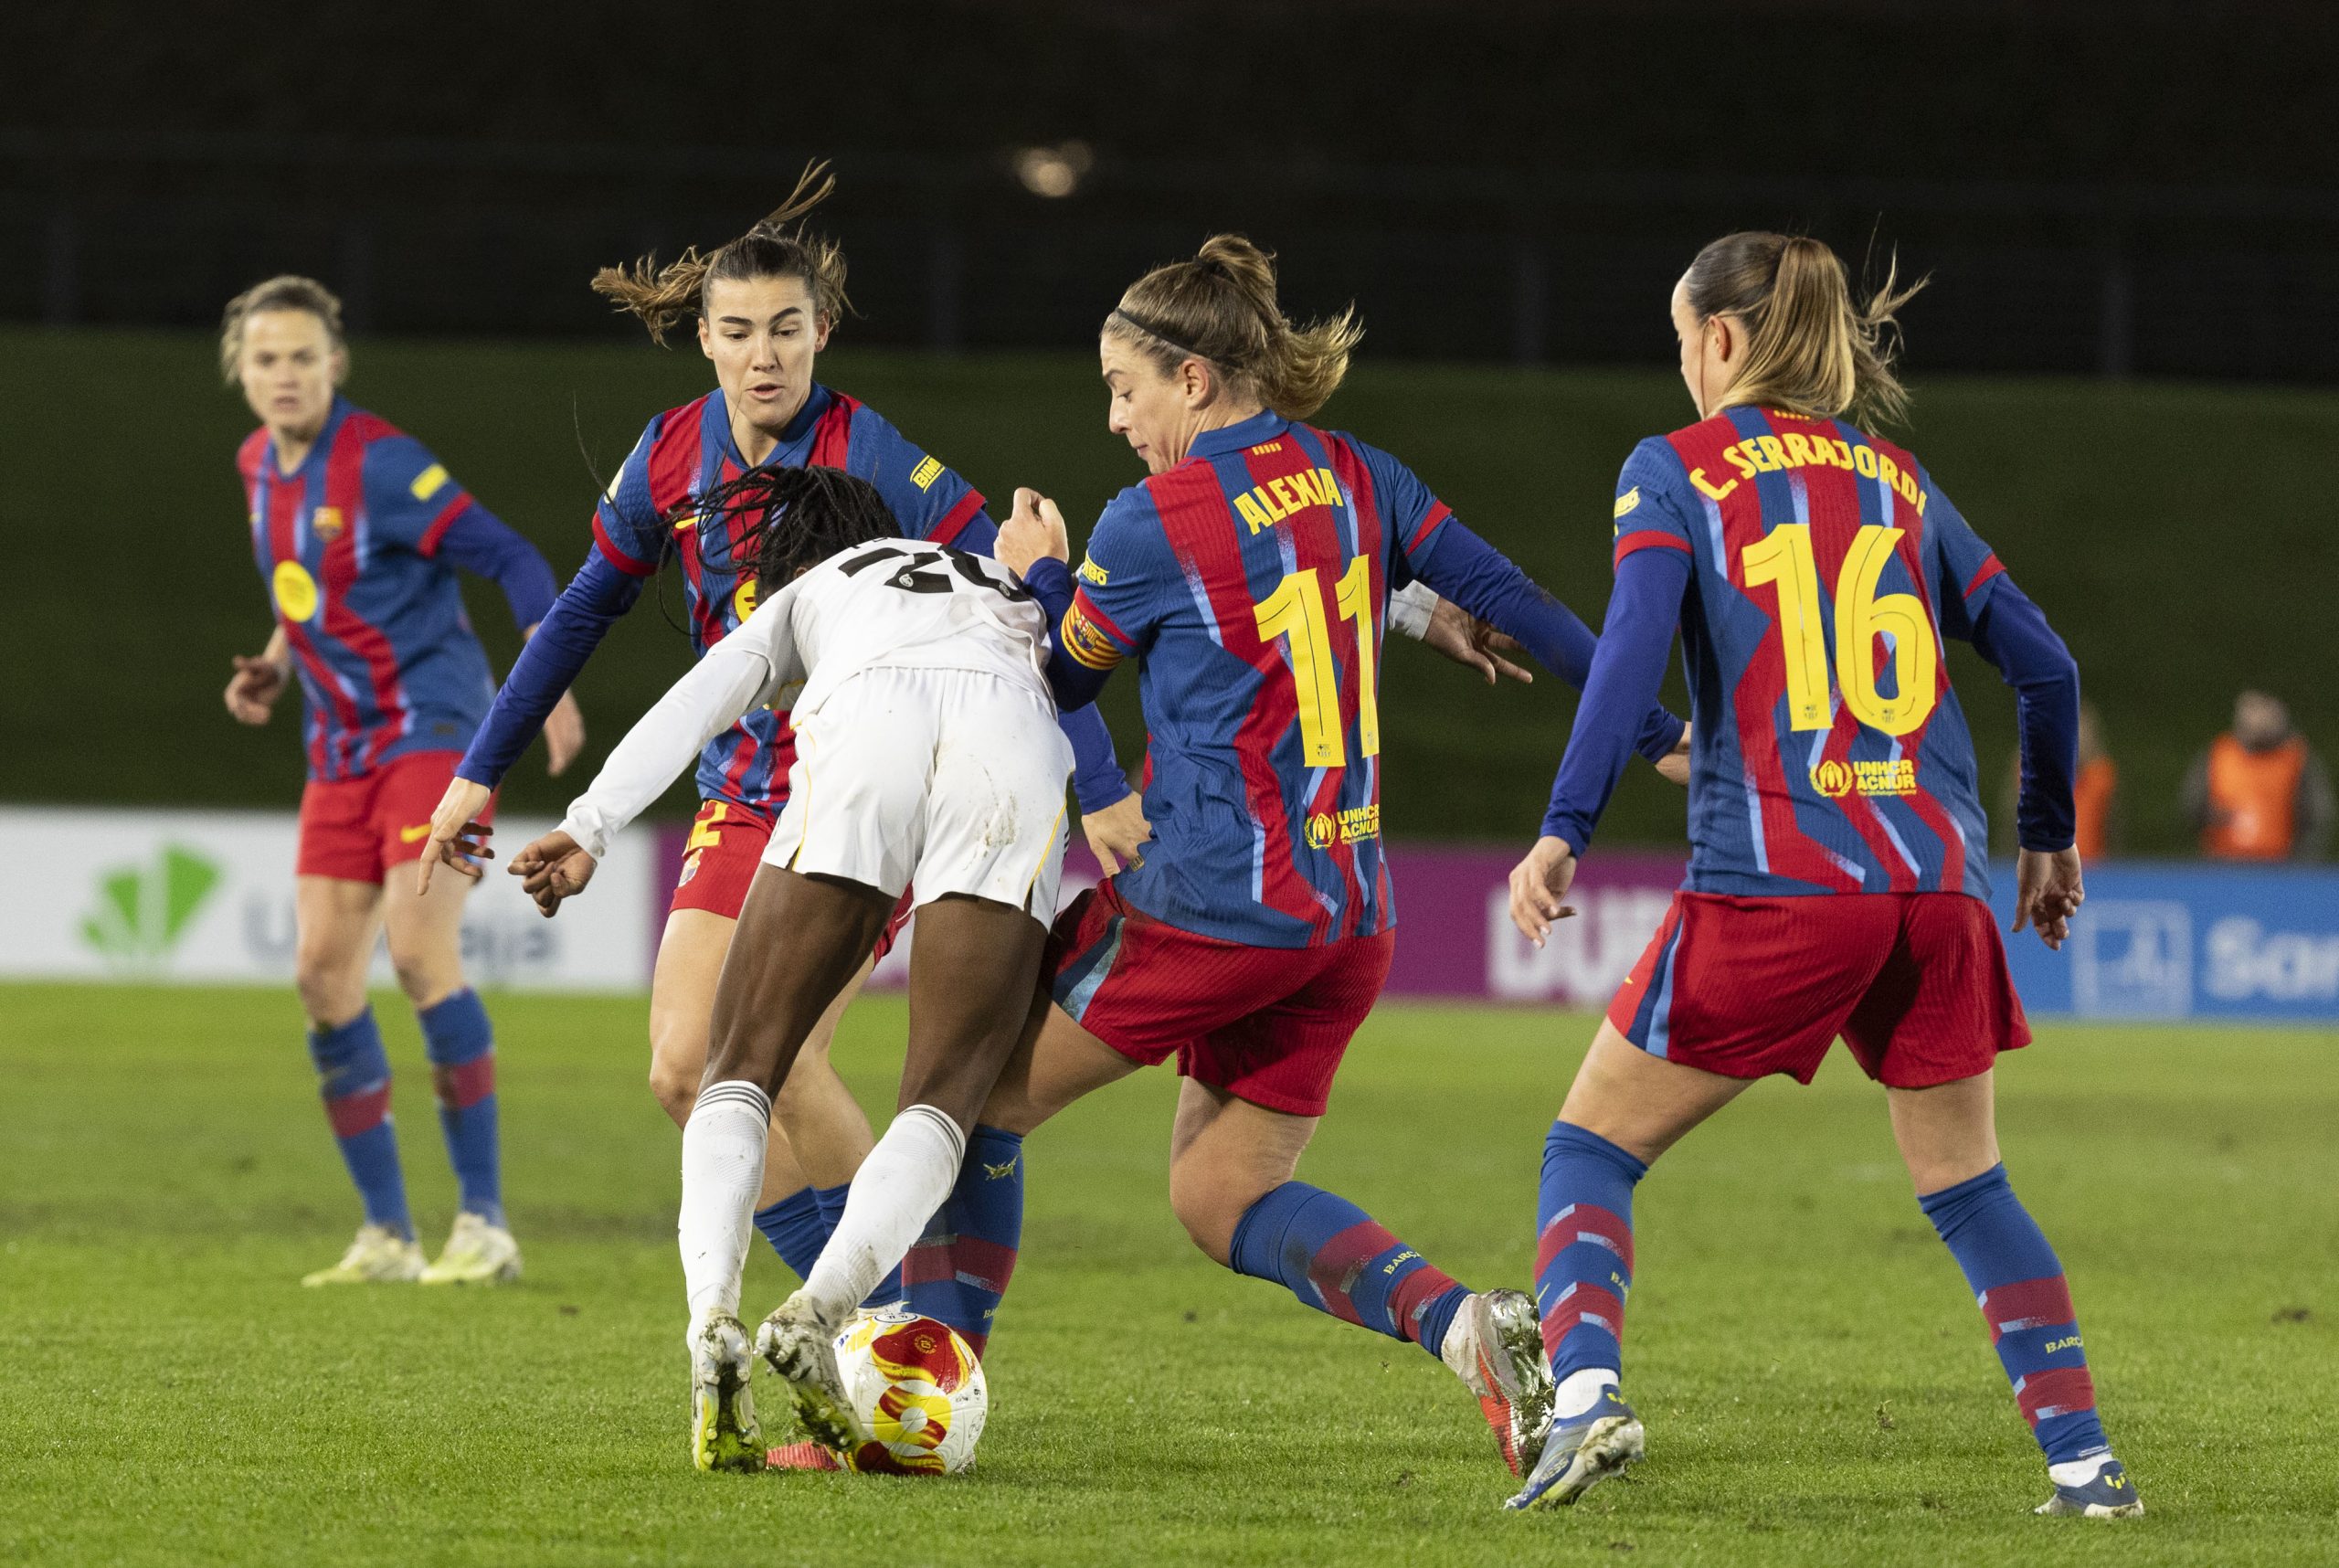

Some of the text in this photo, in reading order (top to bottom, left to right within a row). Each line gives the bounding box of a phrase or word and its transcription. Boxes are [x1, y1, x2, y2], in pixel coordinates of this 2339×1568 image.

[1723, 432, 1927, 517] SERRAJORDI
[1233, 468, 1343, 535] ALEXIA
[1741, 524, 1936, 736] 16
[1253, 554, 1380, 768] 11
[1853, 759, 1913, 776] UNHCR
[1856, 774, 1916, 790] ACNUR
[1337, 803, 1379, 825] UNHCR
[1340, 818, 1379, 840] ACNUR
